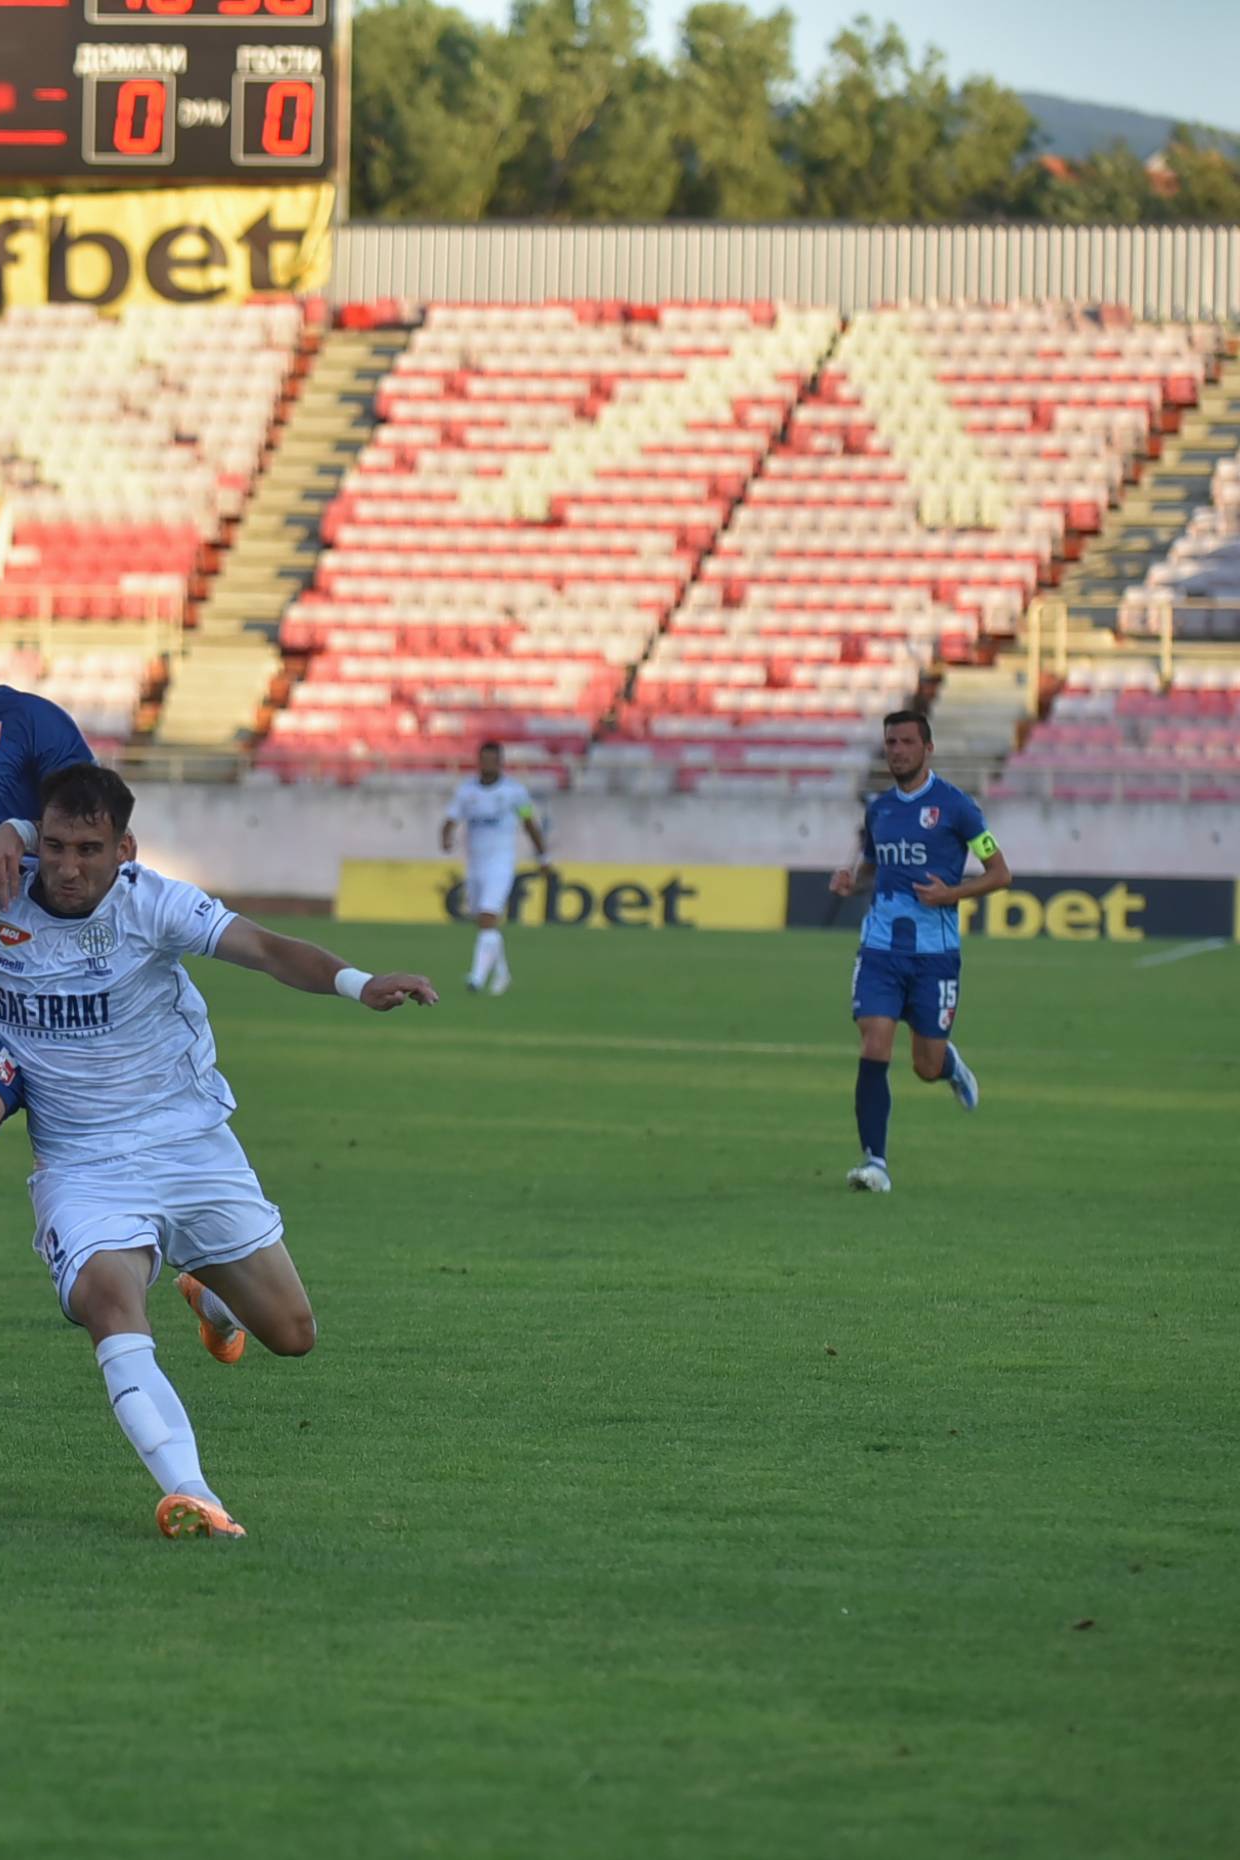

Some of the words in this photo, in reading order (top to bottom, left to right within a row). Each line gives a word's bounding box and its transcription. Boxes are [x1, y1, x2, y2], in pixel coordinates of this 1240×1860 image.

[113, 79, 166, 155] 0
[262, 80, 315, 156] 0
[876, 838, 927, 865] mts
[938, 979, 957, 1009] 15
